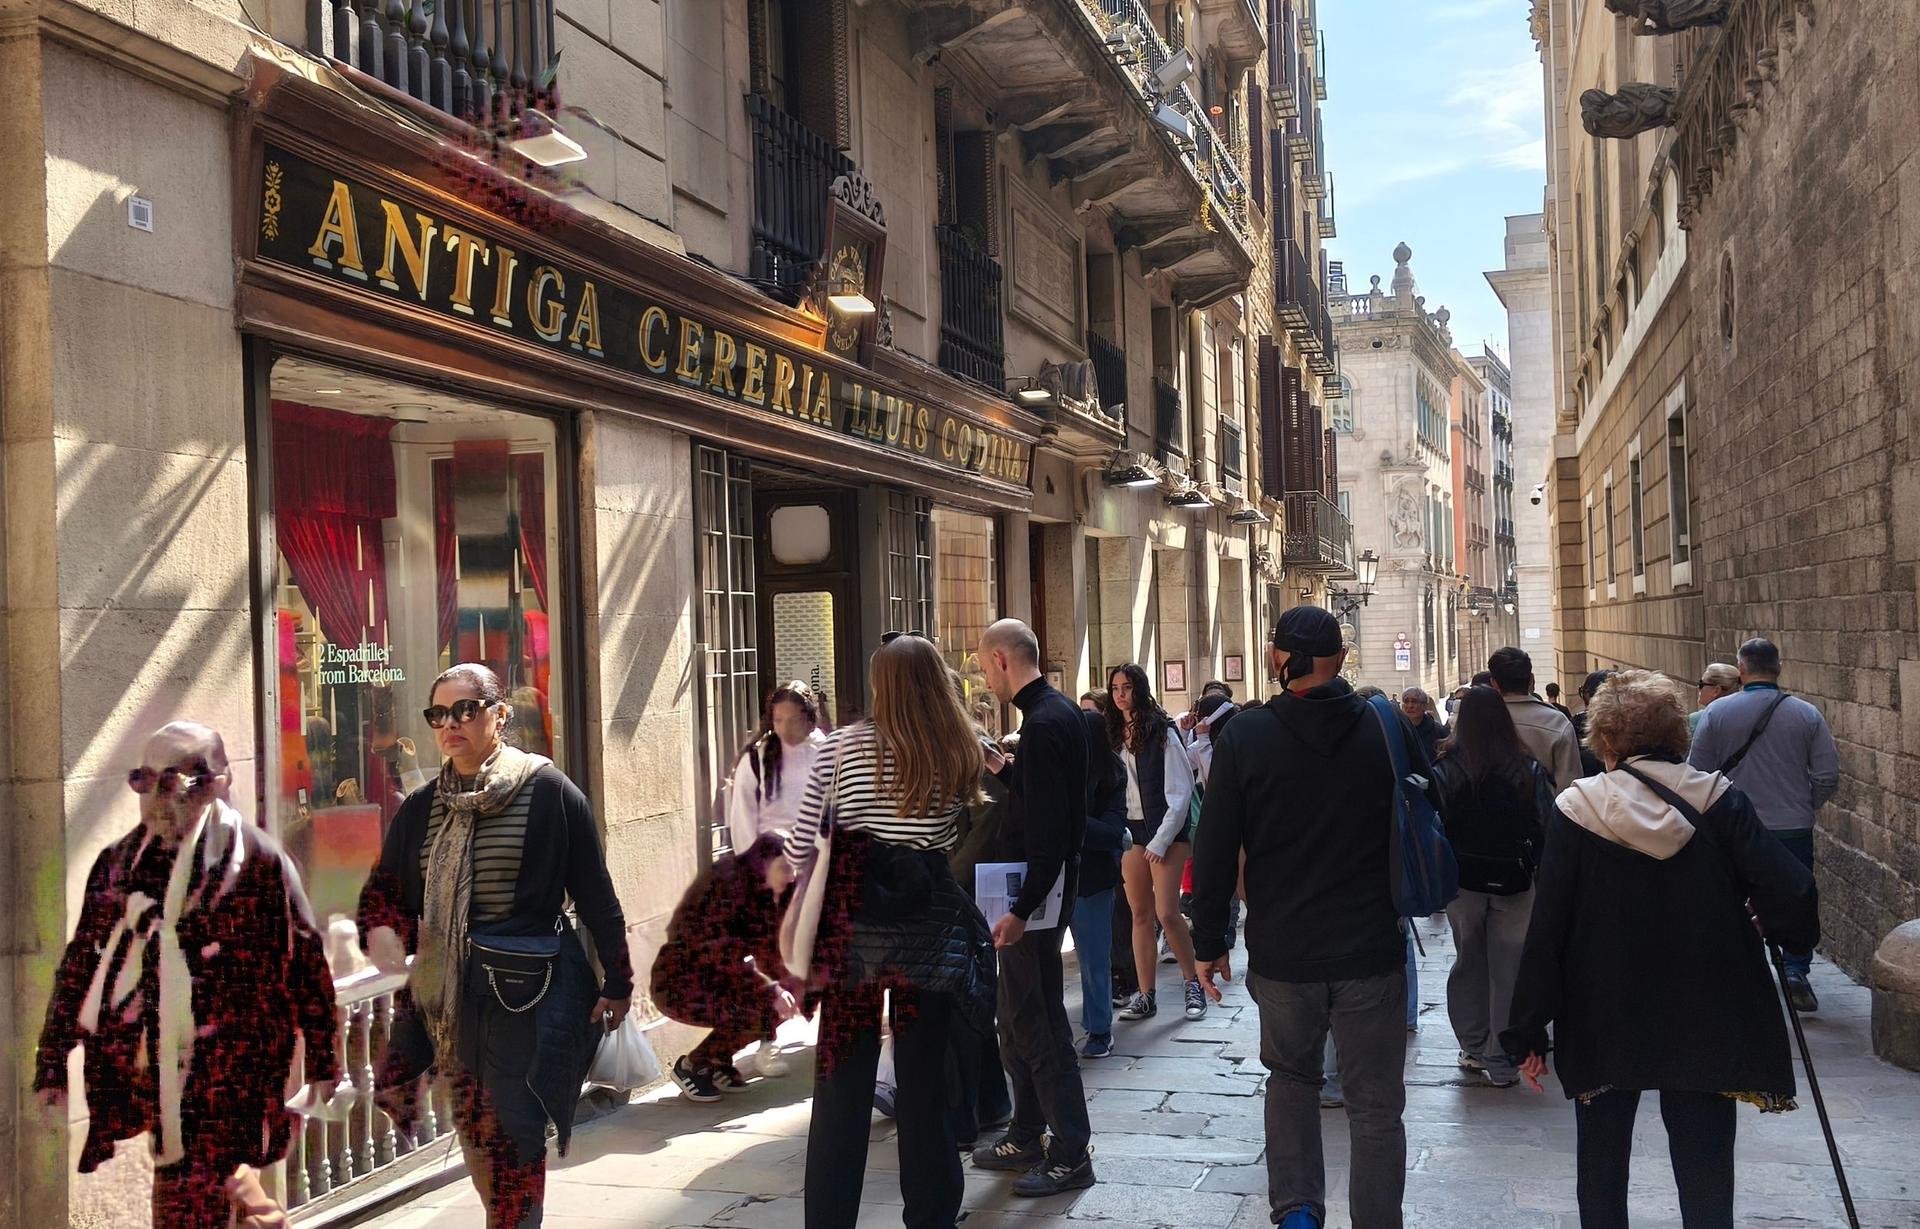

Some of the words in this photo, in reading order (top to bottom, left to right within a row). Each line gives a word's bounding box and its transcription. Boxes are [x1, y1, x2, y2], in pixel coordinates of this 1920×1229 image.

[308, 180, 604, 358] ANTIGA
[639, 306, 833, 427] CERERIA
[852, 383, 929, 454] LLUIS
[942, 418, 1024, 481] CODINA
[318, 665, 346, 685] from
[348, 663, 406, 684] Barcelona.
